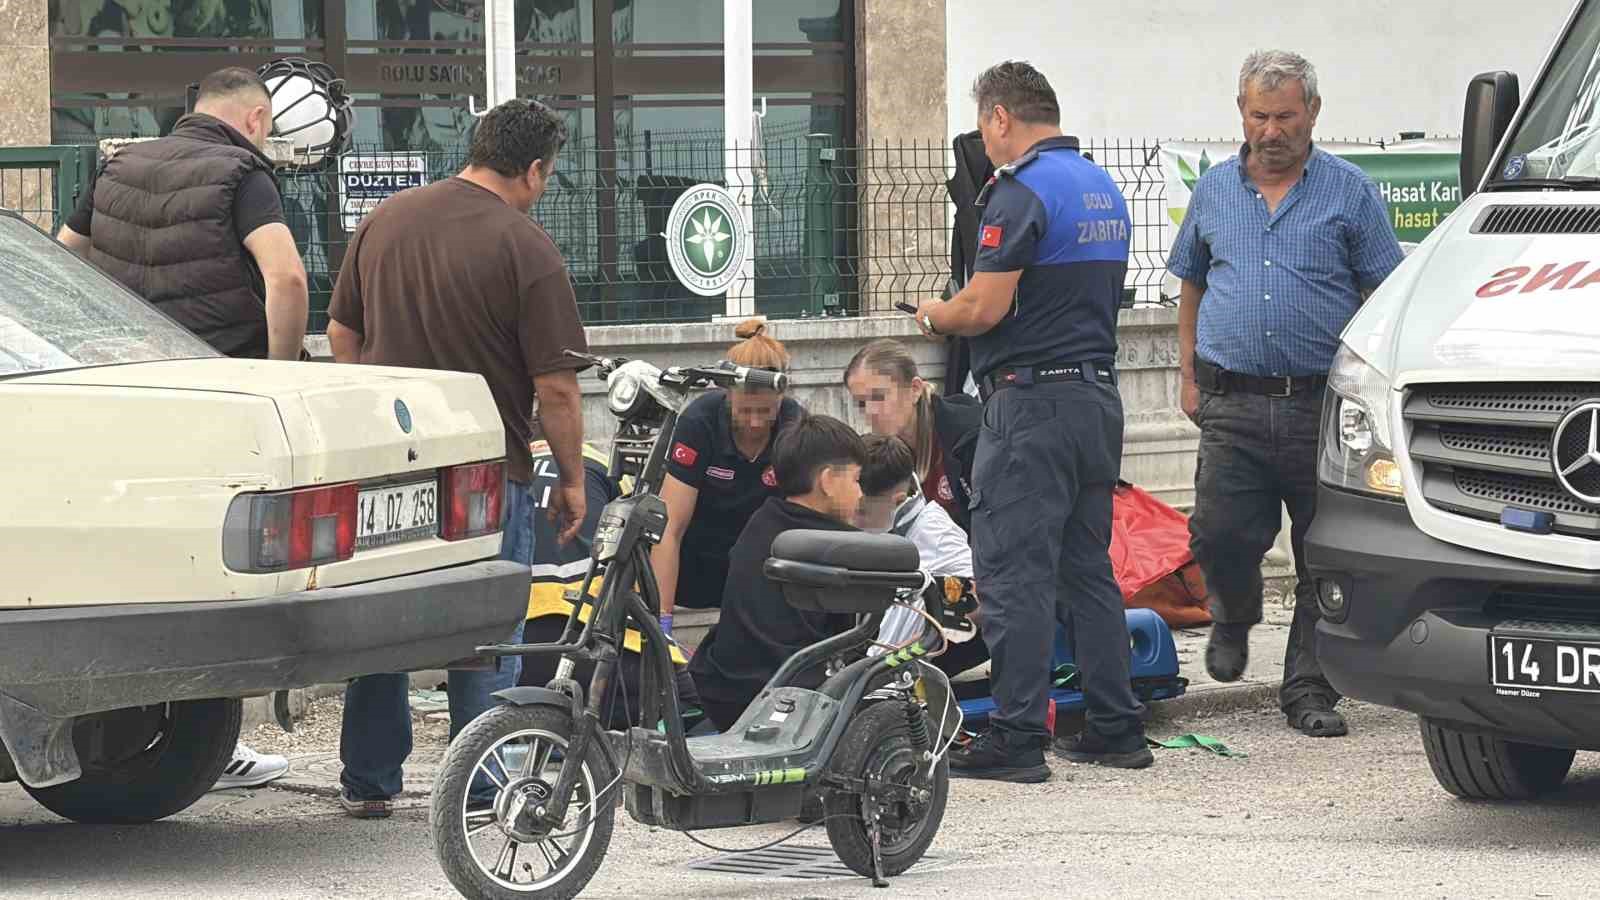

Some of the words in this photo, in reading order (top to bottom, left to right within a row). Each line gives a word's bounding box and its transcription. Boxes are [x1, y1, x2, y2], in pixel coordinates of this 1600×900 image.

[381, 65, 424, 81] BOLU
[1083, 192, 1113, 209] BOLU
[1380, 181, 1427, 203] Hasat
[1430, 181, 1459, 202] Kar
[1394, 206, 1439, 229] hasat
[1078, 219, 1129, 244] ZABITA
[1039, 367, 1081, 376] ZABITA
[360, 495, 376, 535] 14
[412, 487, 435, 527] 258
[1502, 641, 1540, 682] 14
[1556, 645, 1600, 685] DR
